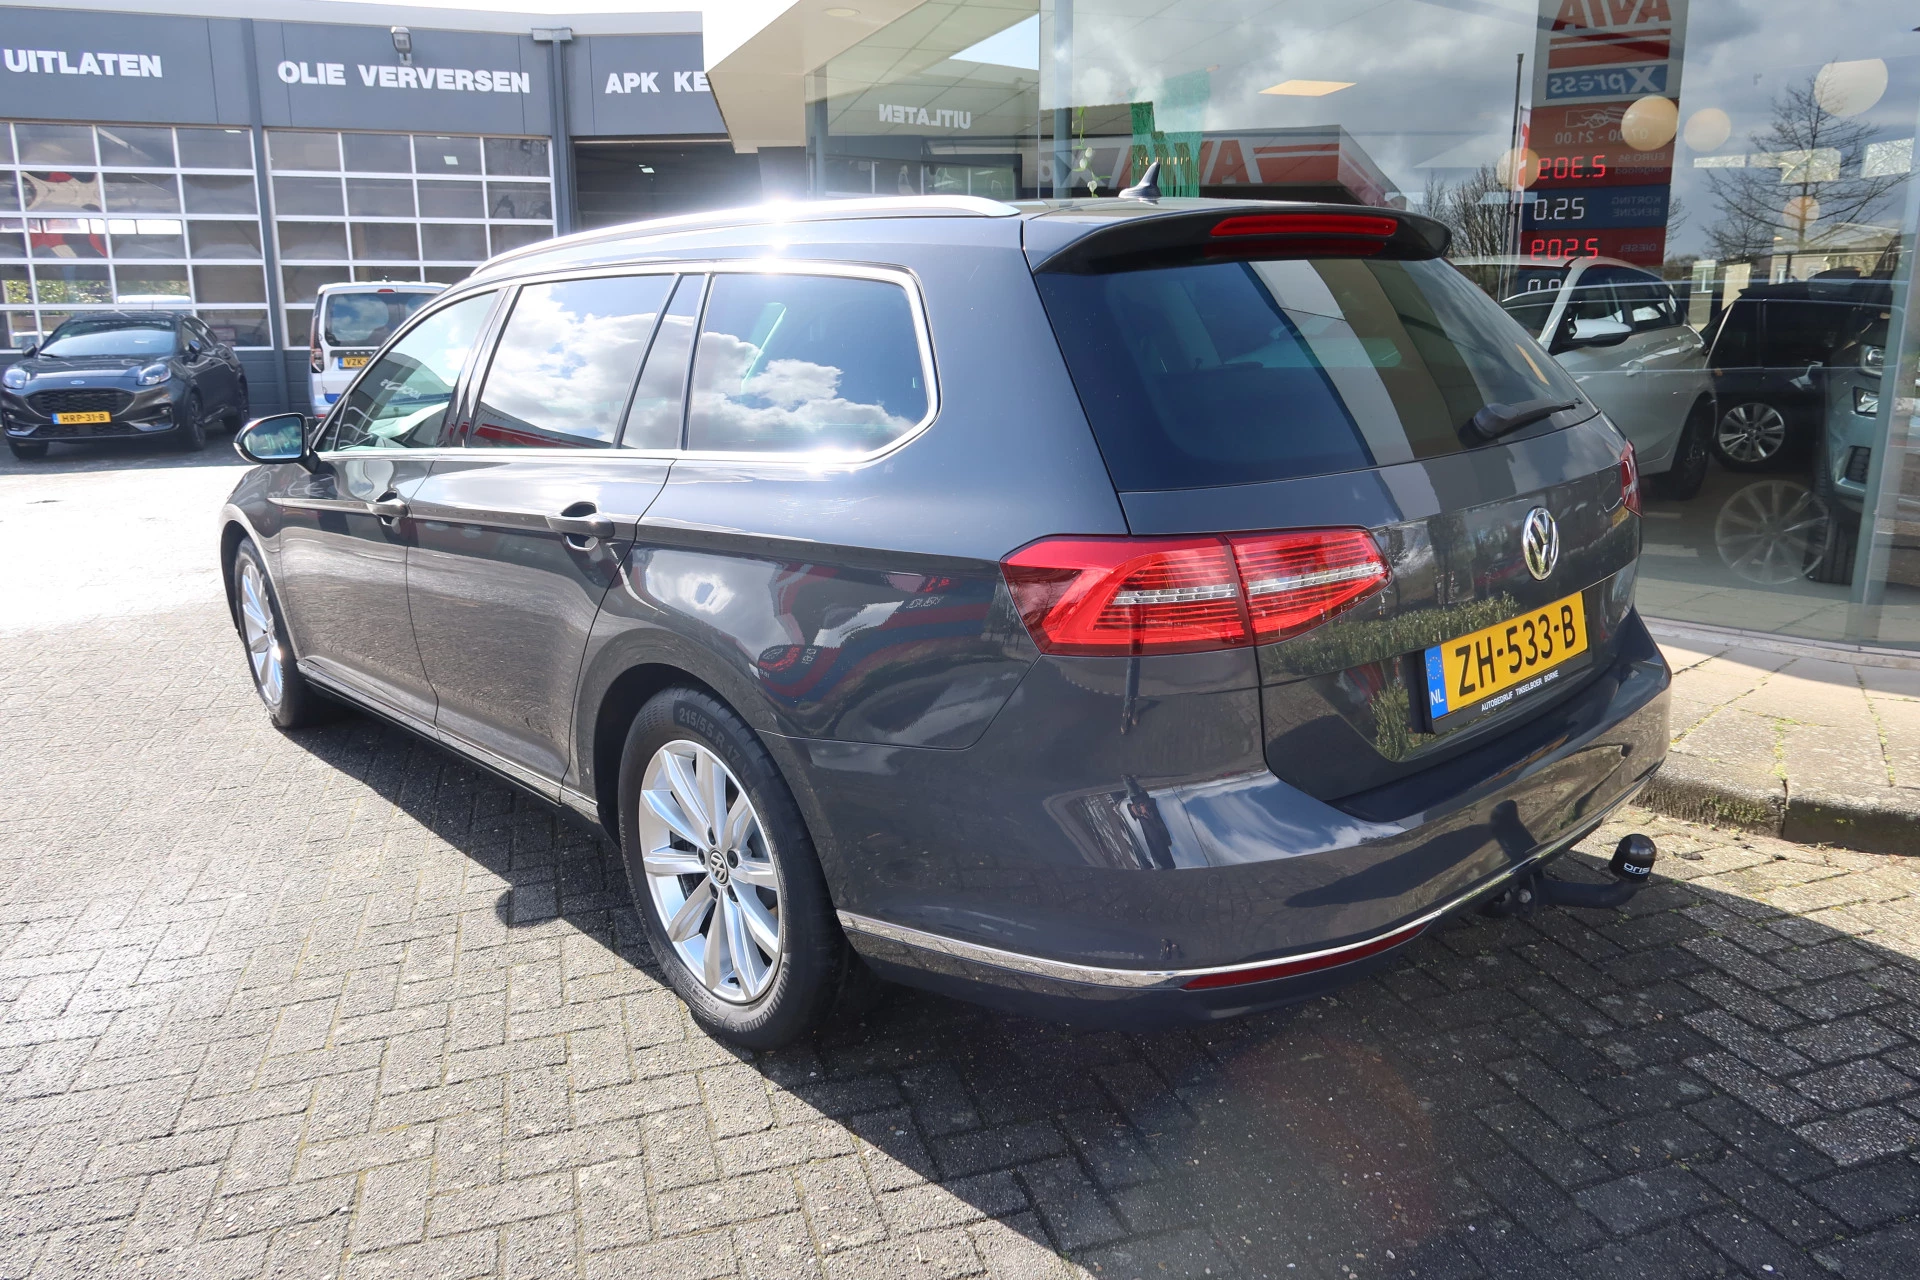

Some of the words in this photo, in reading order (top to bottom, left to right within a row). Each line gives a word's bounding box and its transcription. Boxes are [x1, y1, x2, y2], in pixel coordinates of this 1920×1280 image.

[4, 49, 163, 78] UITLATEN
[277, 60, 347, 86] OLIE
[357, 64, 531, 94] VERVERSEN
[604, 72, 661, 94] APK
[1430, 688, 1445, 705] NL
[1455, 604, 1576, 697] ZH-533-B
[1481, 691, 1514, 712] AUTOBEDRIJF
[679, 707, 715, 738] 215/55
